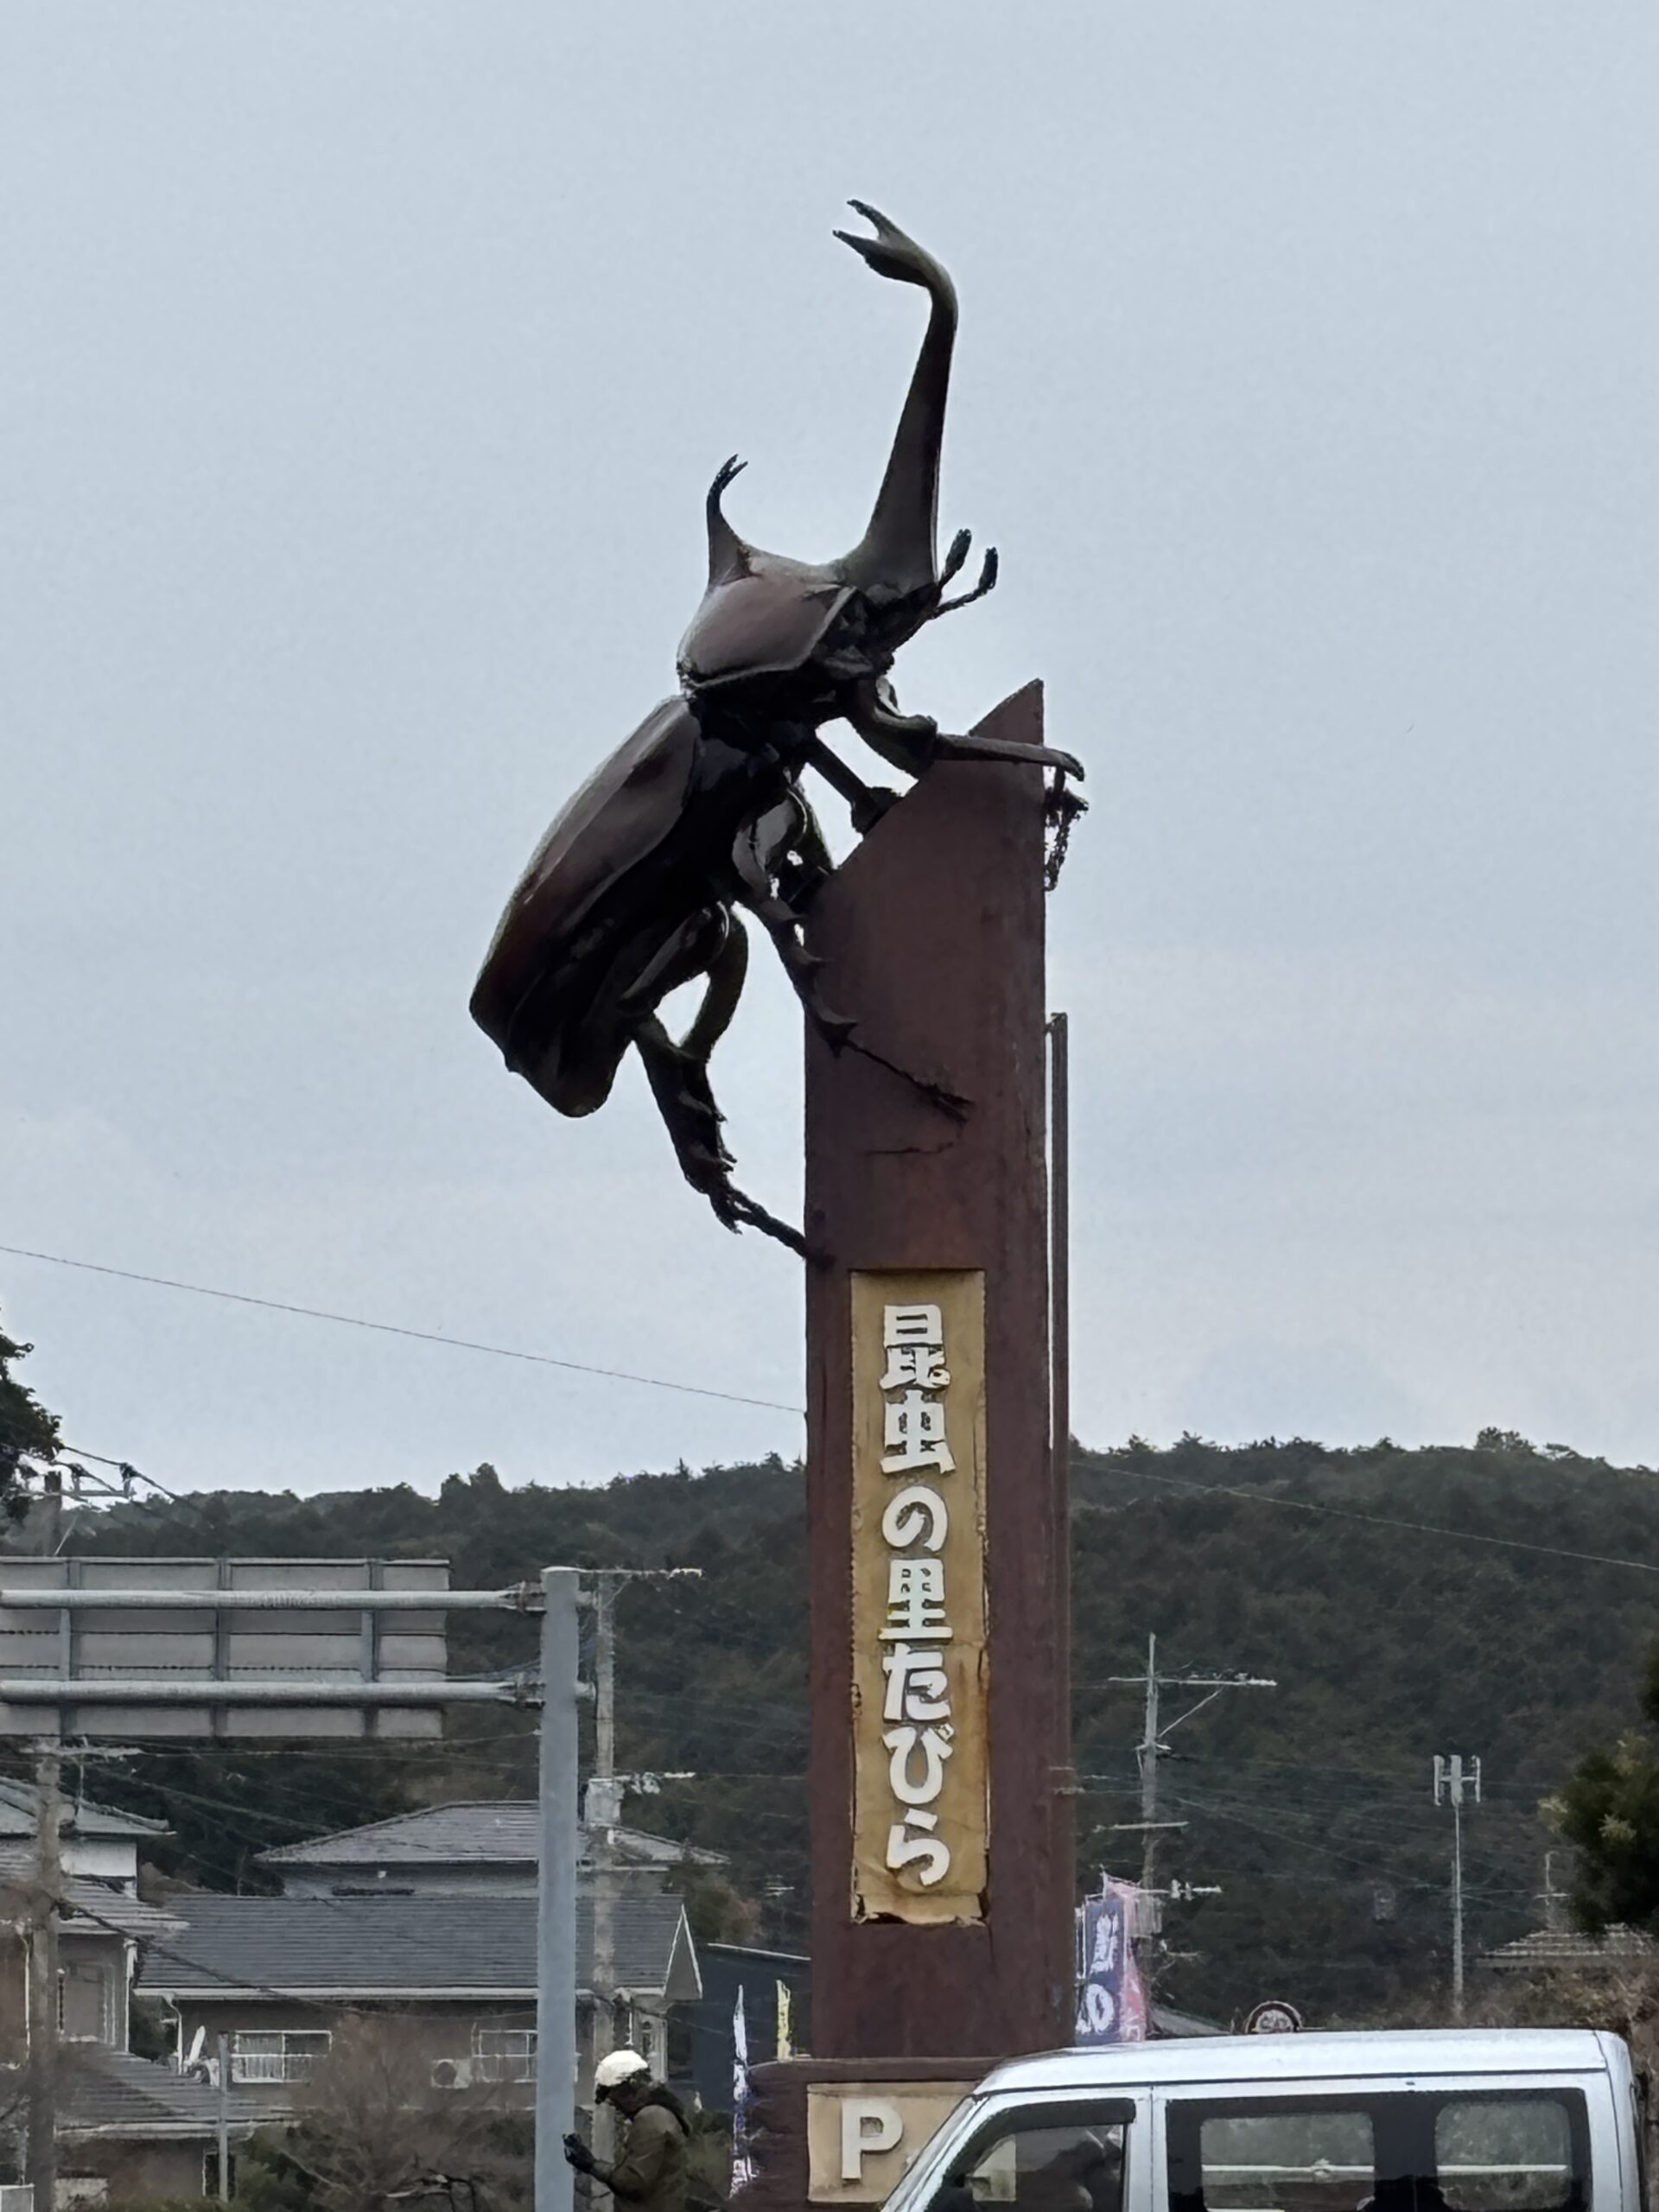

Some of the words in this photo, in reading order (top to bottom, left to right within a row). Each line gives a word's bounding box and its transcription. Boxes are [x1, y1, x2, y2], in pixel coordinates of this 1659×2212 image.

[879, 1304, 956, 1886] 昆虫の里たびら
[842, 2098, 904, 2181] P
